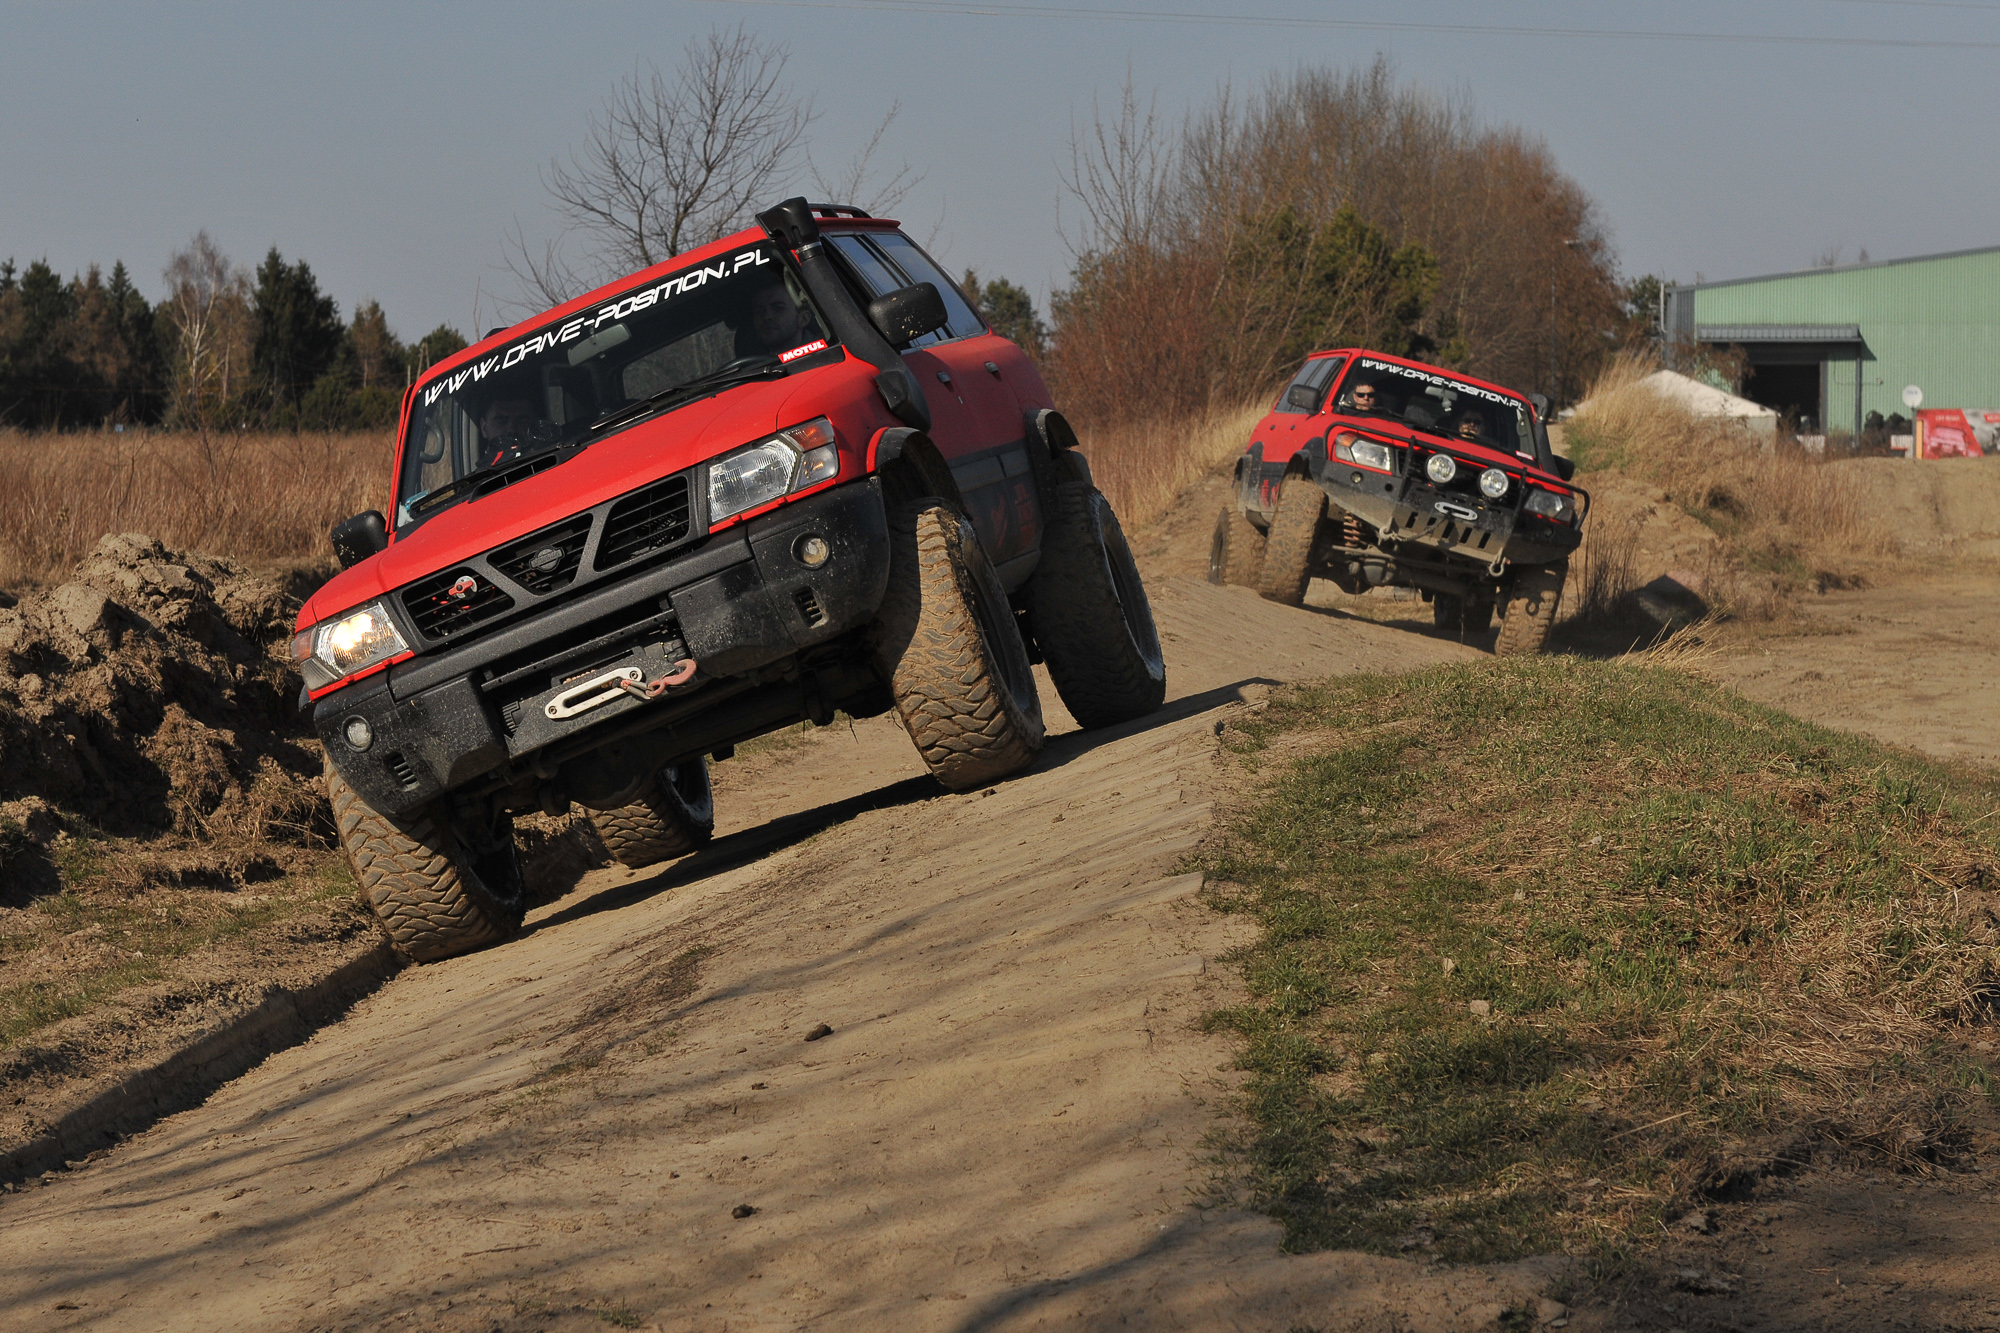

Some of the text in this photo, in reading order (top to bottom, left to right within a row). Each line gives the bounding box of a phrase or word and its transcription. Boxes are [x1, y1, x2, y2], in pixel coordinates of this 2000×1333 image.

[425, 249, 770, 406] WWW.DRIVE-POSITION.PL
[782, 341, 824, 362] MOTUL
[1361, 359, 1524, 411] WWW.DRIVE-POSITION.PL
